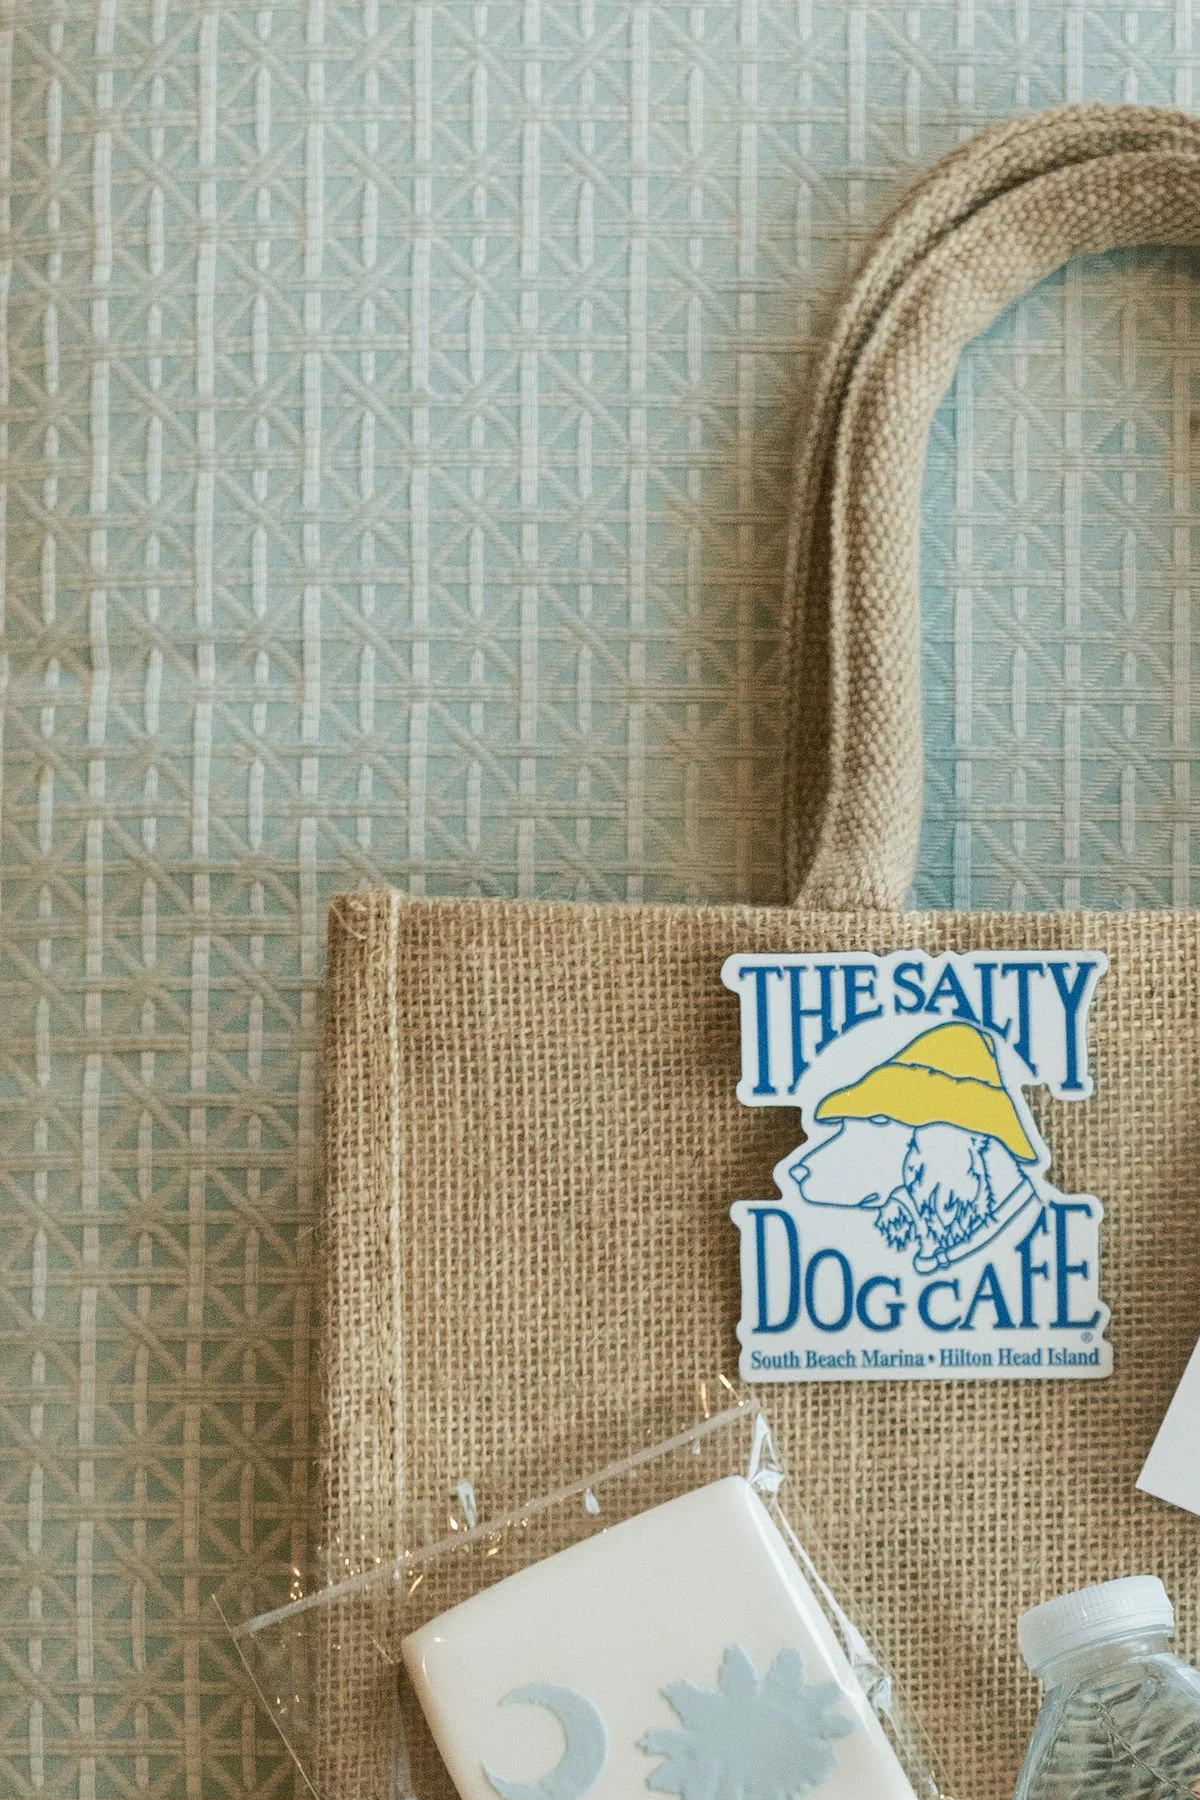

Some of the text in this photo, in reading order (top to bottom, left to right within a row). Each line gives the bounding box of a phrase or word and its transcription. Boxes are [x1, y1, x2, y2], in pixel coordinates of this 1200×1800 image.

[739, 961, 1097, 1094] THE SALTY
[747, 1207, 907, 1334] DOG
[751, 1347, 1101, 1370] South Beach Marina Hilton Head Island
